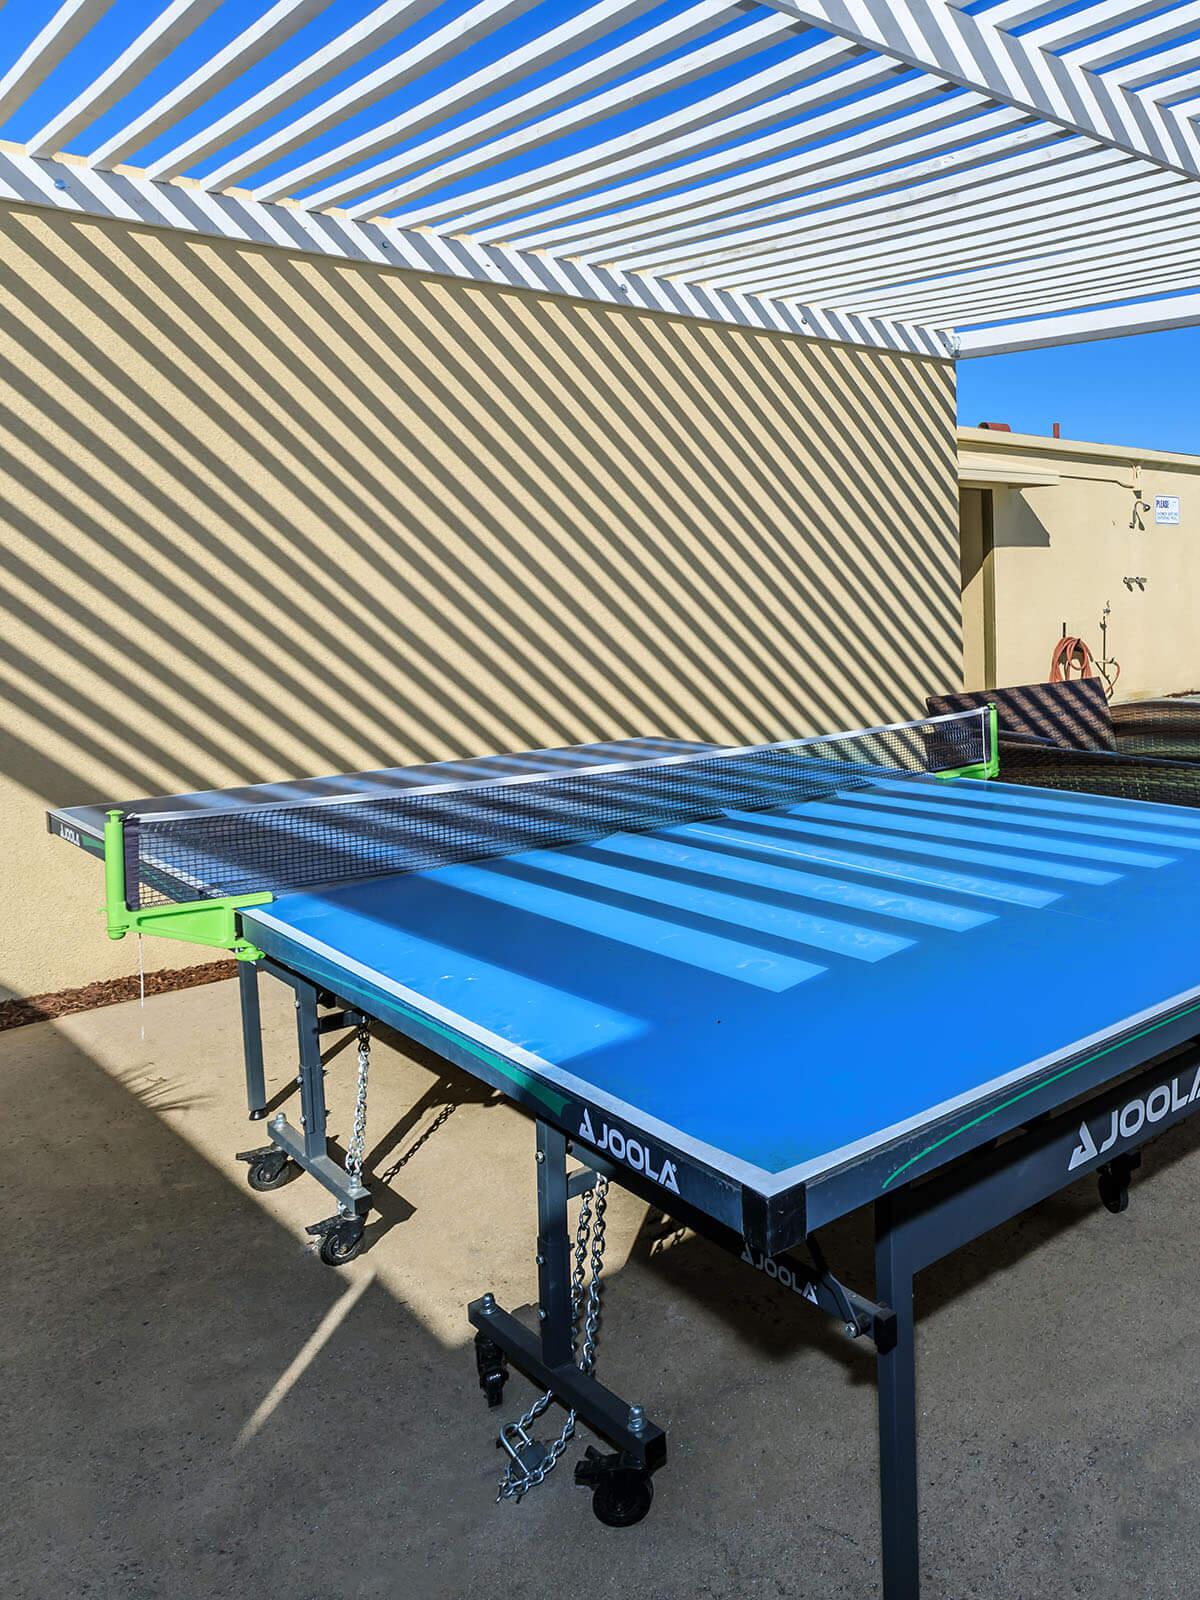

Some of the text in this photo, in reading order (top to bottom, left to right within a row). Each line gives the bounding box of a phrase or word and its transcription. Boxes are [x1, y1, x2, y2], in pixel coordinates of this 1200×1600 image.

[1156, 499, 1169, 508] PLEASE
[595, 1123, 681, 1195] JOOLA
[752, 1253, 818, 1305] JOOLA
